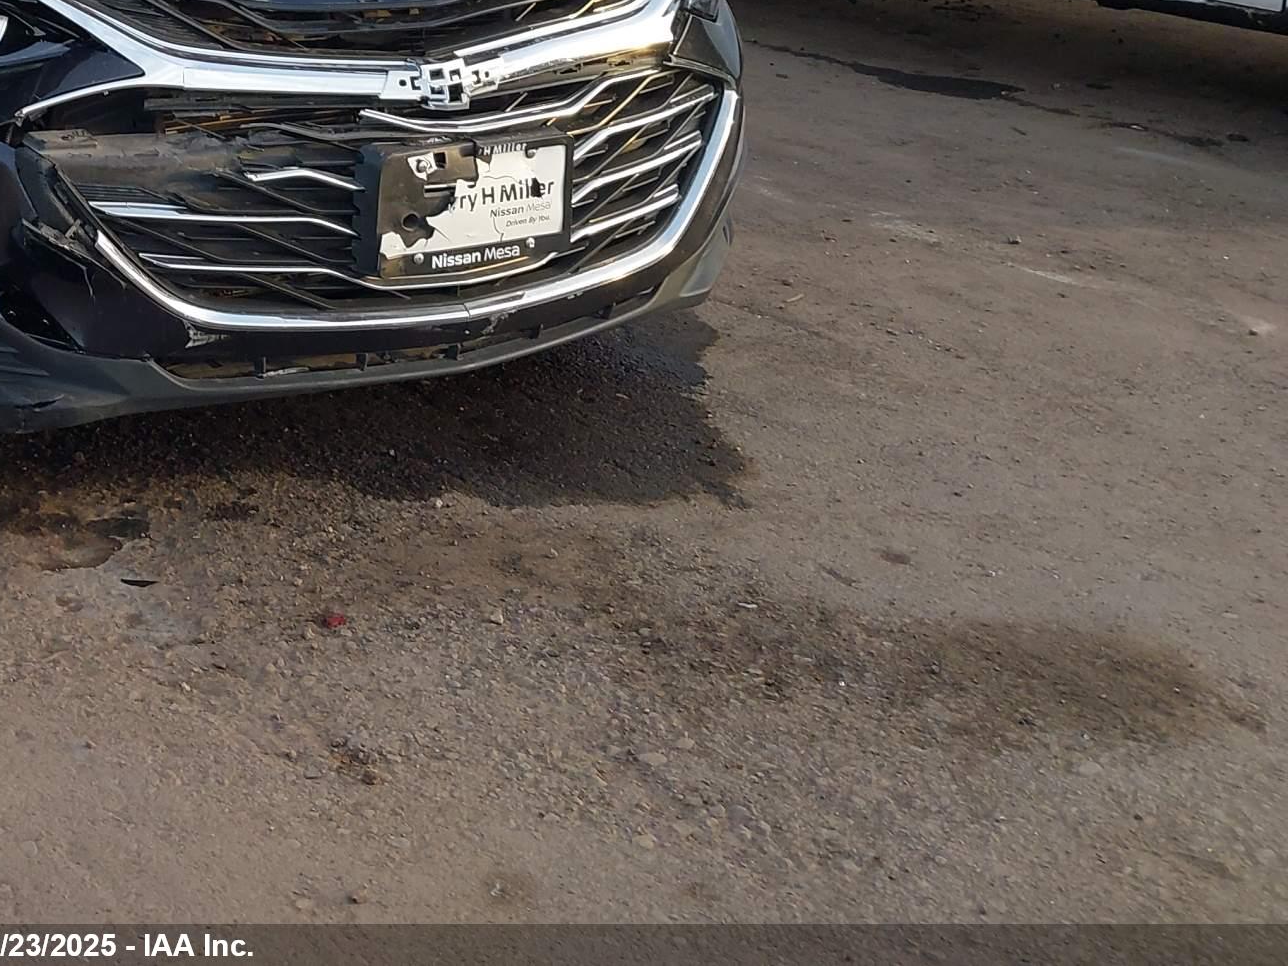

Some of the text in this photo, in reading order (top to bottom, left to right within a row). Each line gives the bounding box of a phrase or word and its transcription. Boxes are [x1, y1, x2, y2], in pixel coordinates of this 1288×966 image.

[482, 186, 495, 205] H
[500, 178, 554, 202] Miler
[490, 201, 551, 218] Nissan Mesa
[432, 244, 520, 269] Nissan Mesa
